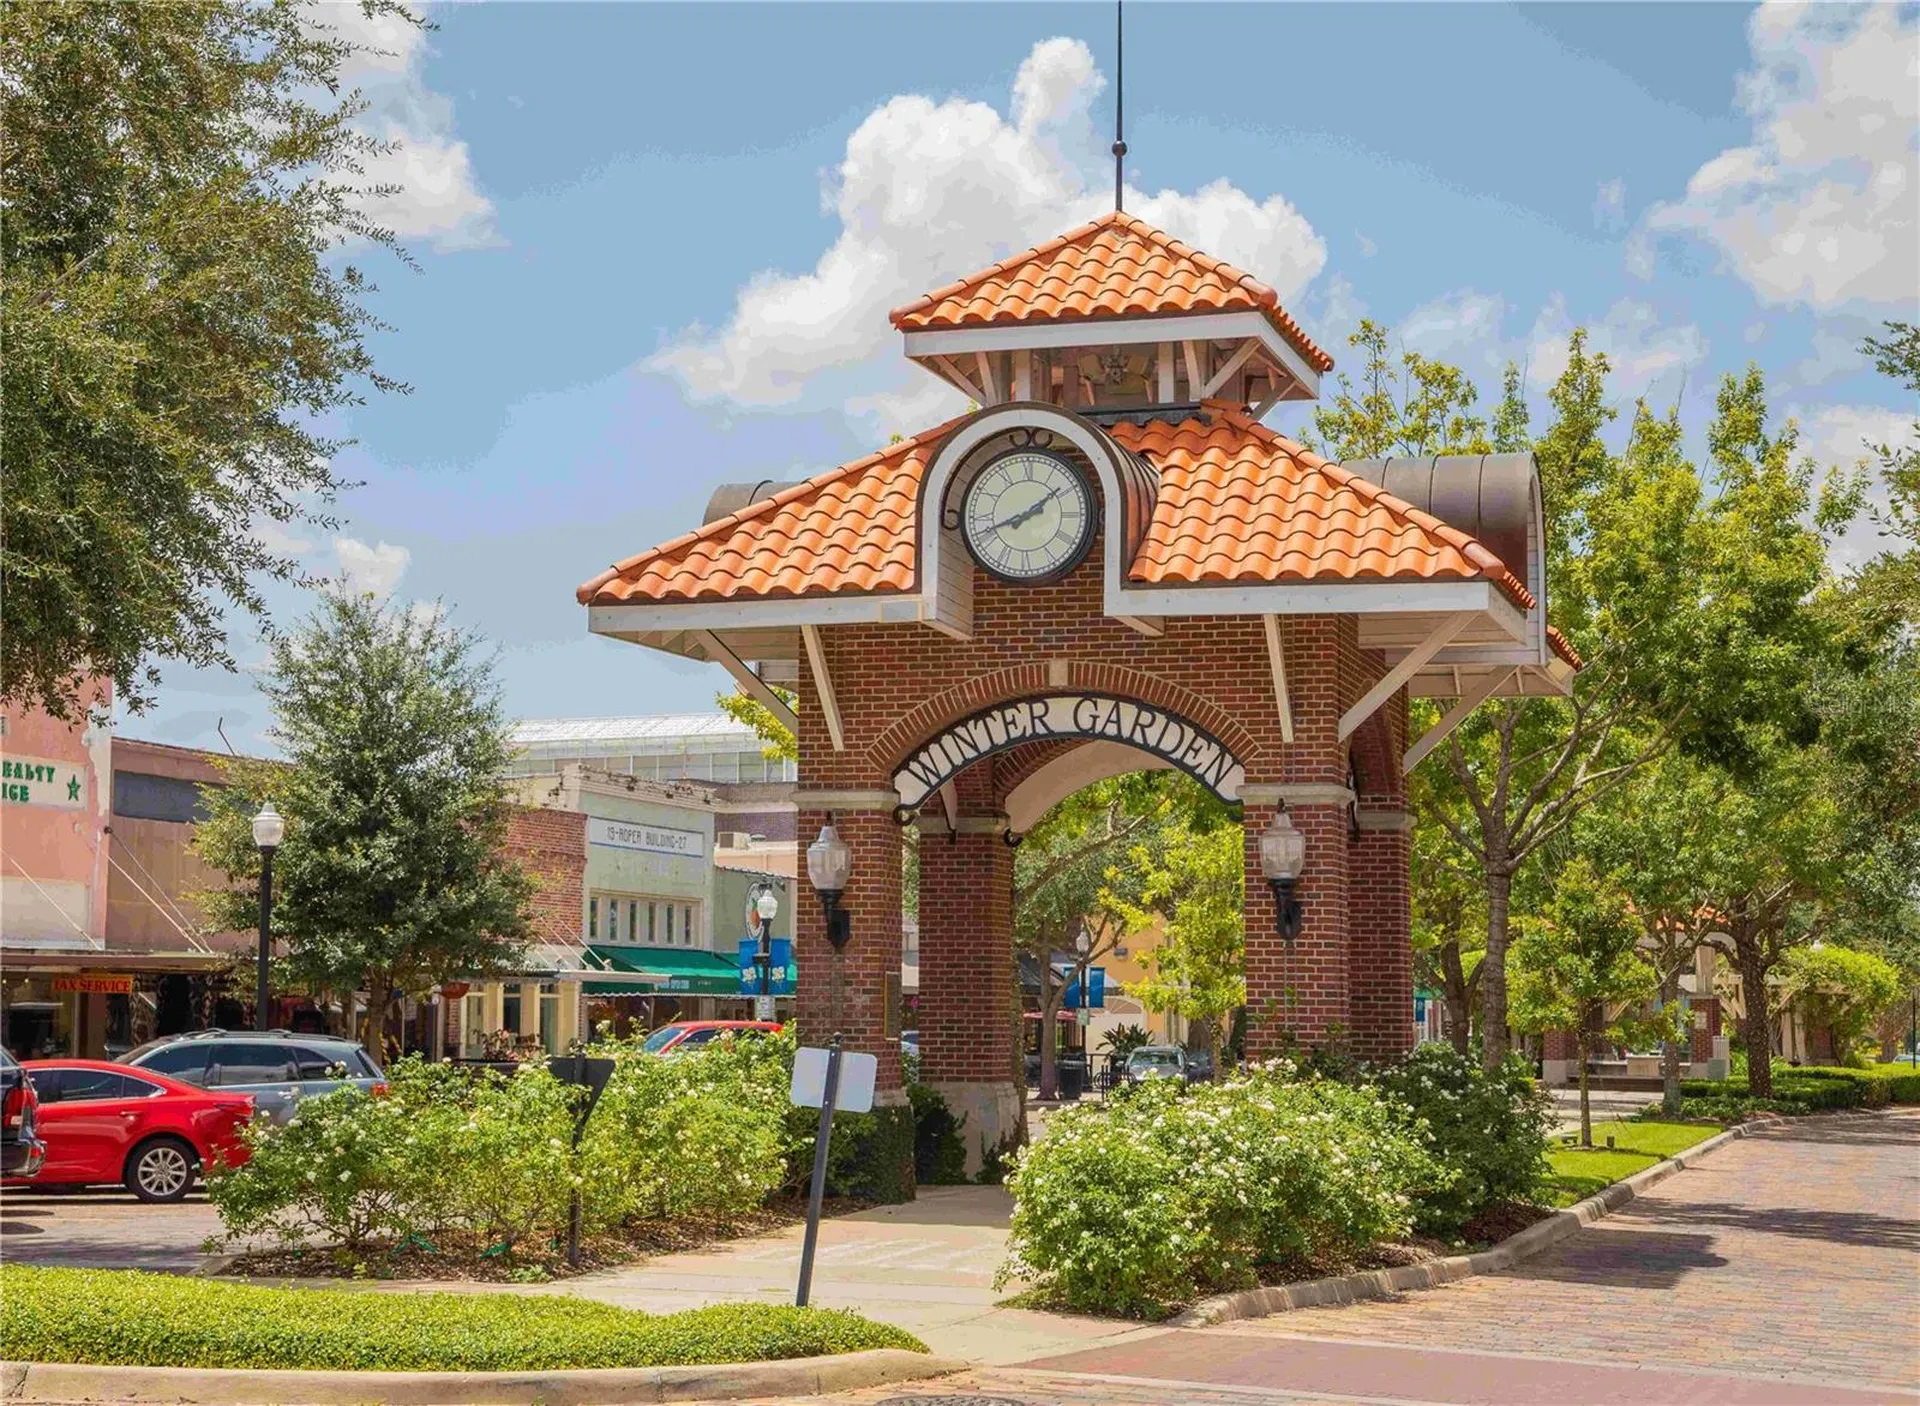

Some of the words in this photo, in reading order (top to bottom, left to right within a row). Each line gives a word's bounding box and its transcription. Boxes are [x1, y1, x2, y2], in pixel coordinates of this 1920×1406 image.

[907, 700, 1053, 788] WINTER
[1072, 696, 1237, 791] GARDEN
[54, 979, 78, 991] TAX
[80, 979, 130, 992] SERVICE
